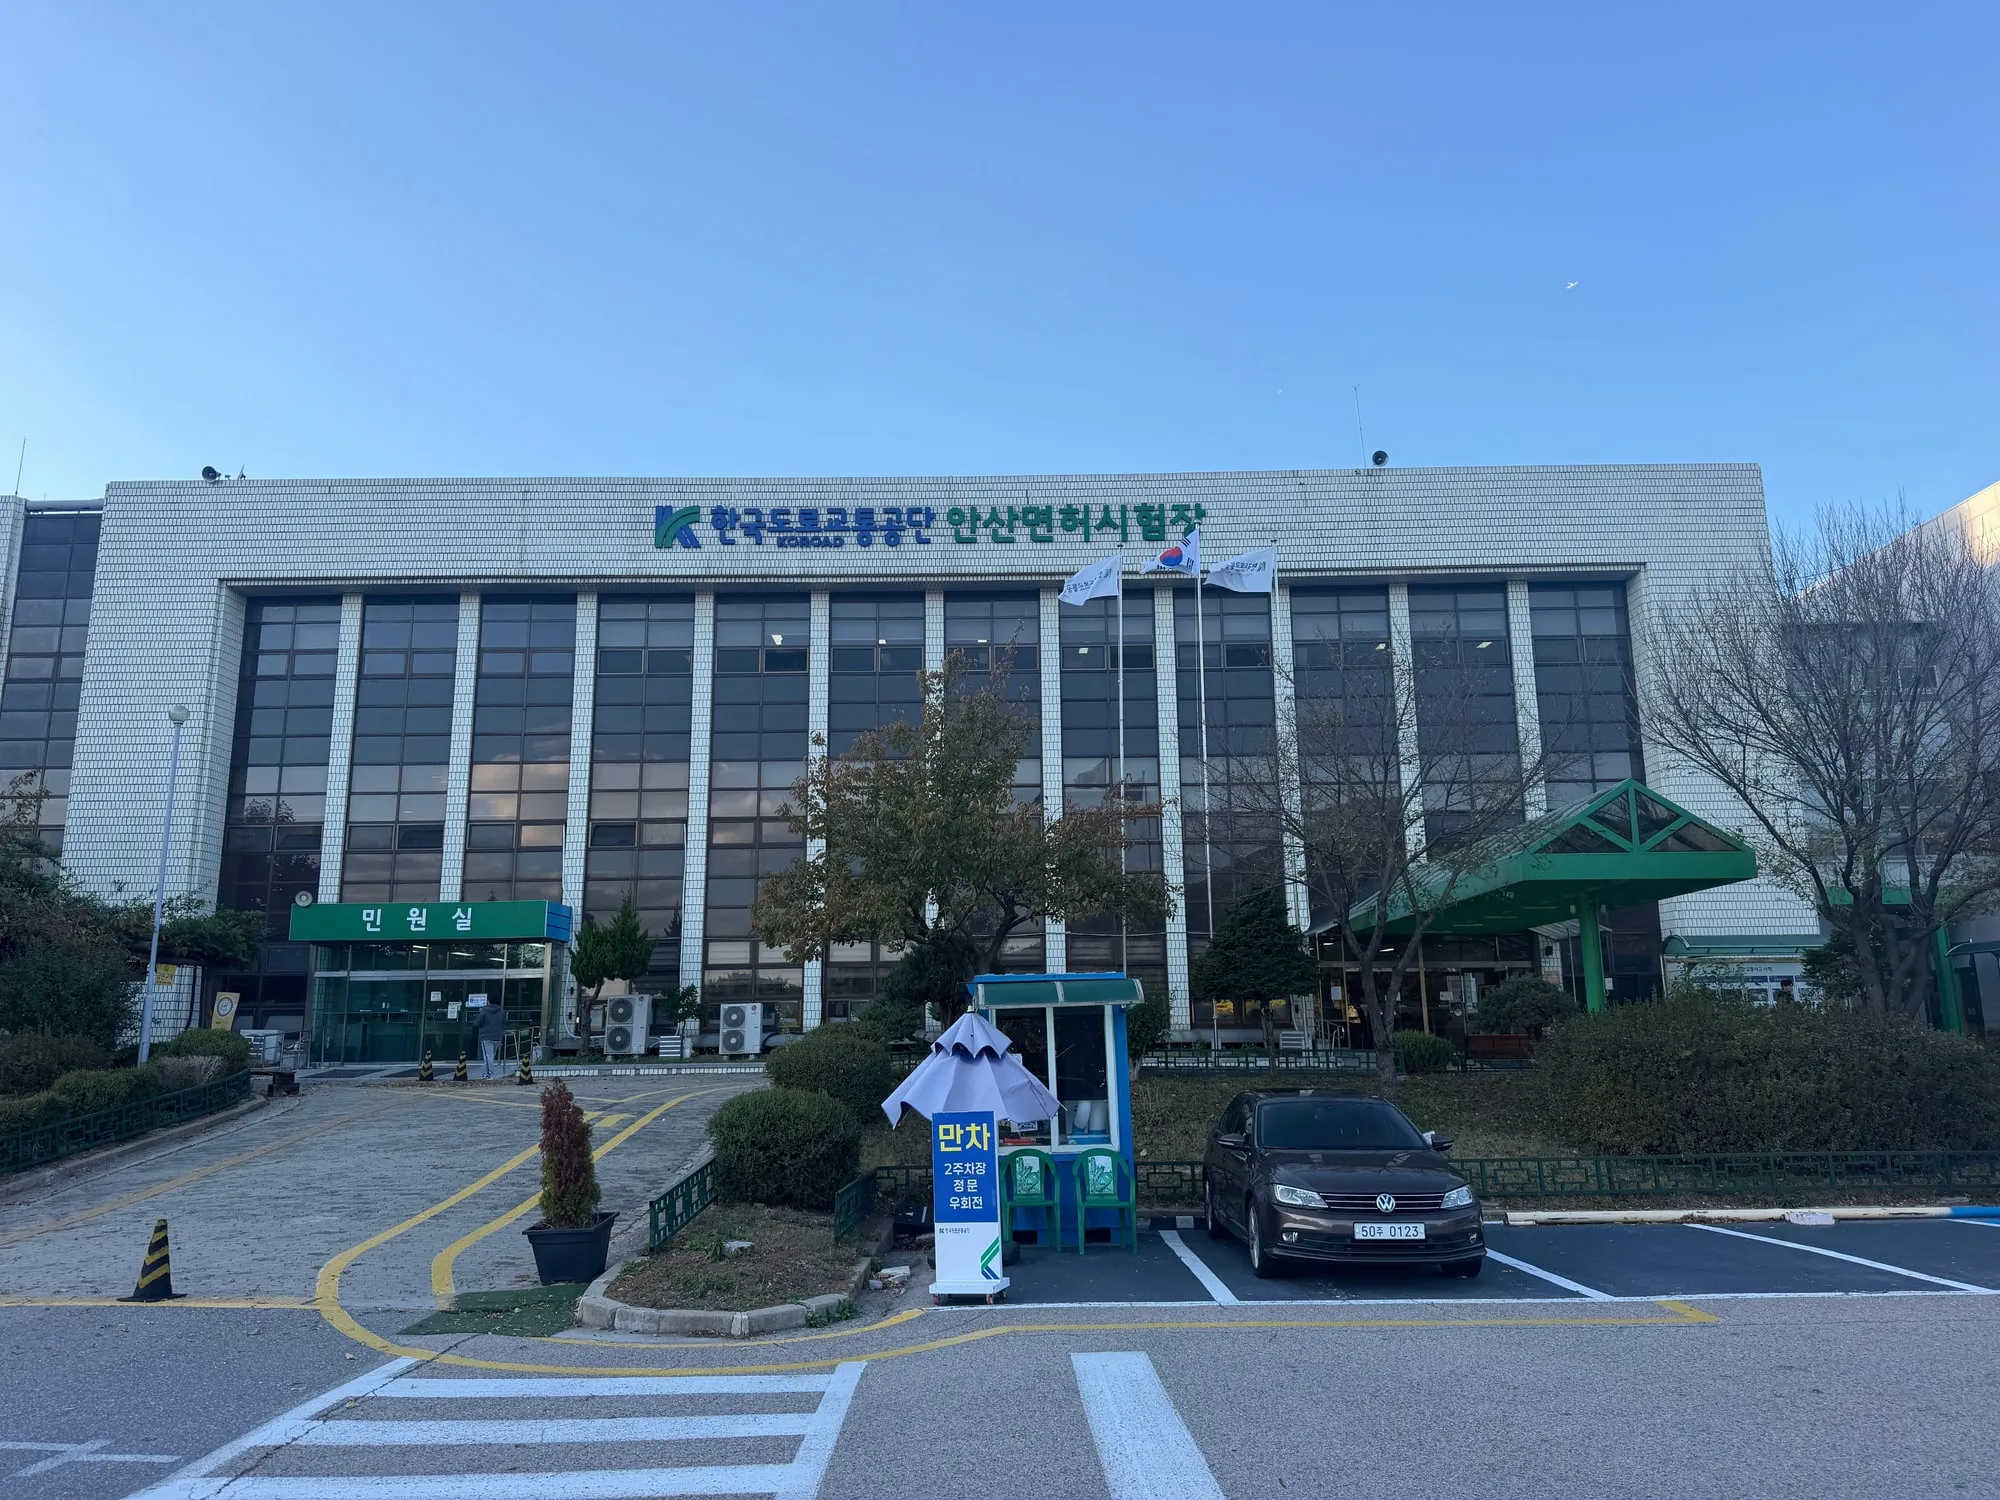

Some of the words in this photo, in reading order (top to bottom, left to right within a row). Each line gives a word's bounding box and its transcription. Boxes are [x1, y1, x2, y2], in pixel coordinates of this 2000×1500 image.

[711, 505, 936, 547] 한국도로교통공단
[947, 503, 1206, 543] 안산면허시험장
[777, 536, 845, 548] KOROAD
[938, 1123, 990, 1152] 만차
[944, 1162, 987, 1175] 2주차장
[949, 1196, 983, 1210] 우회전
[1361, 1225, 1384, 1238] 50주
[1389, 1225, 1419, 1238] 0123
